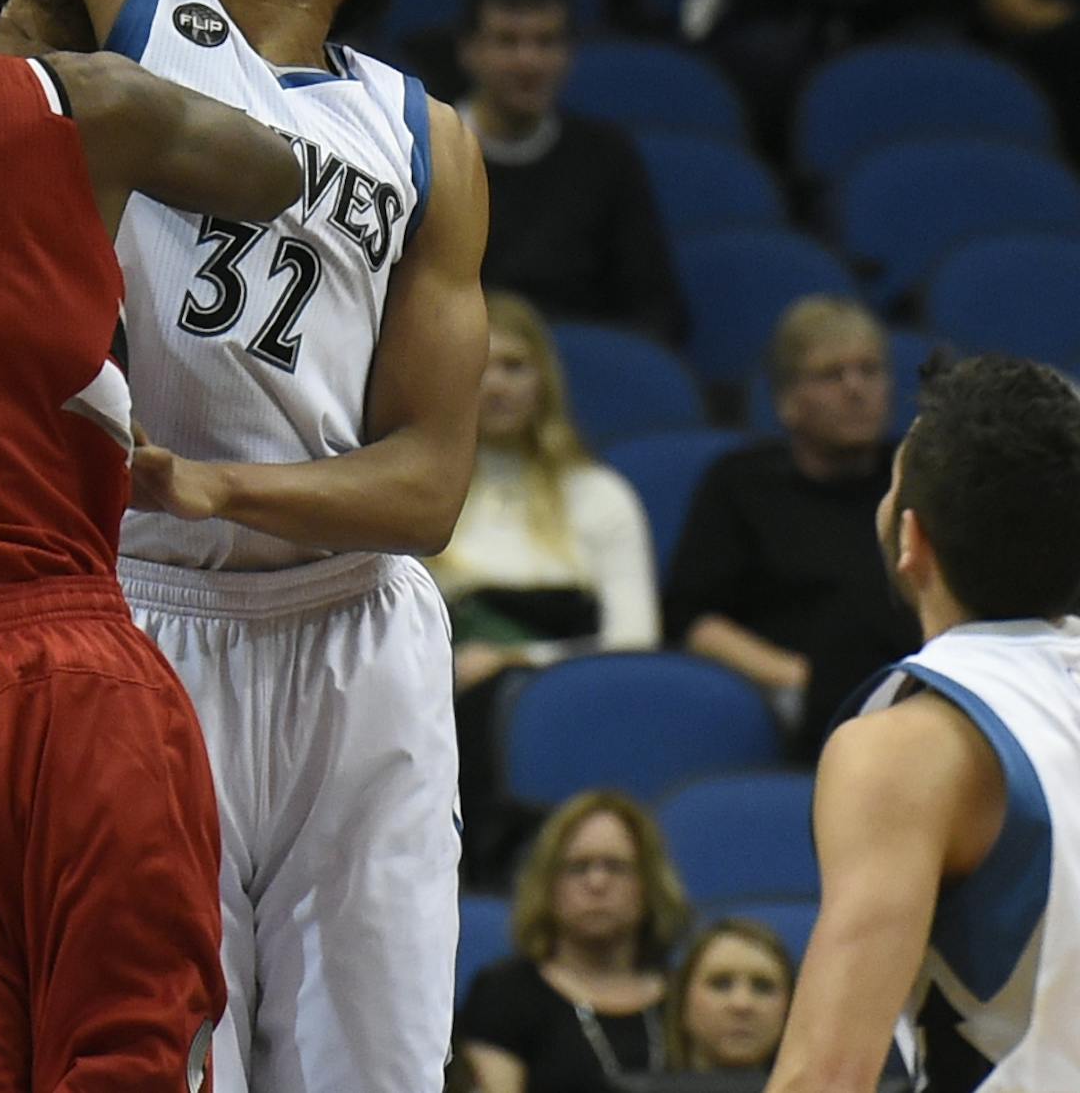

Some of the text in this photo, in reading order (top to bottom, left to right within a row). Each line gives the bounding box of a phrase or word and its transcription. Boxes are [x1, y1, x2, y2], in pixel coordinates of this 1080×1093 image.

[180, 12, 224, 33] FLIP
[271, 124, 404, 273] VES
[177, 214, 322, 375] 32
